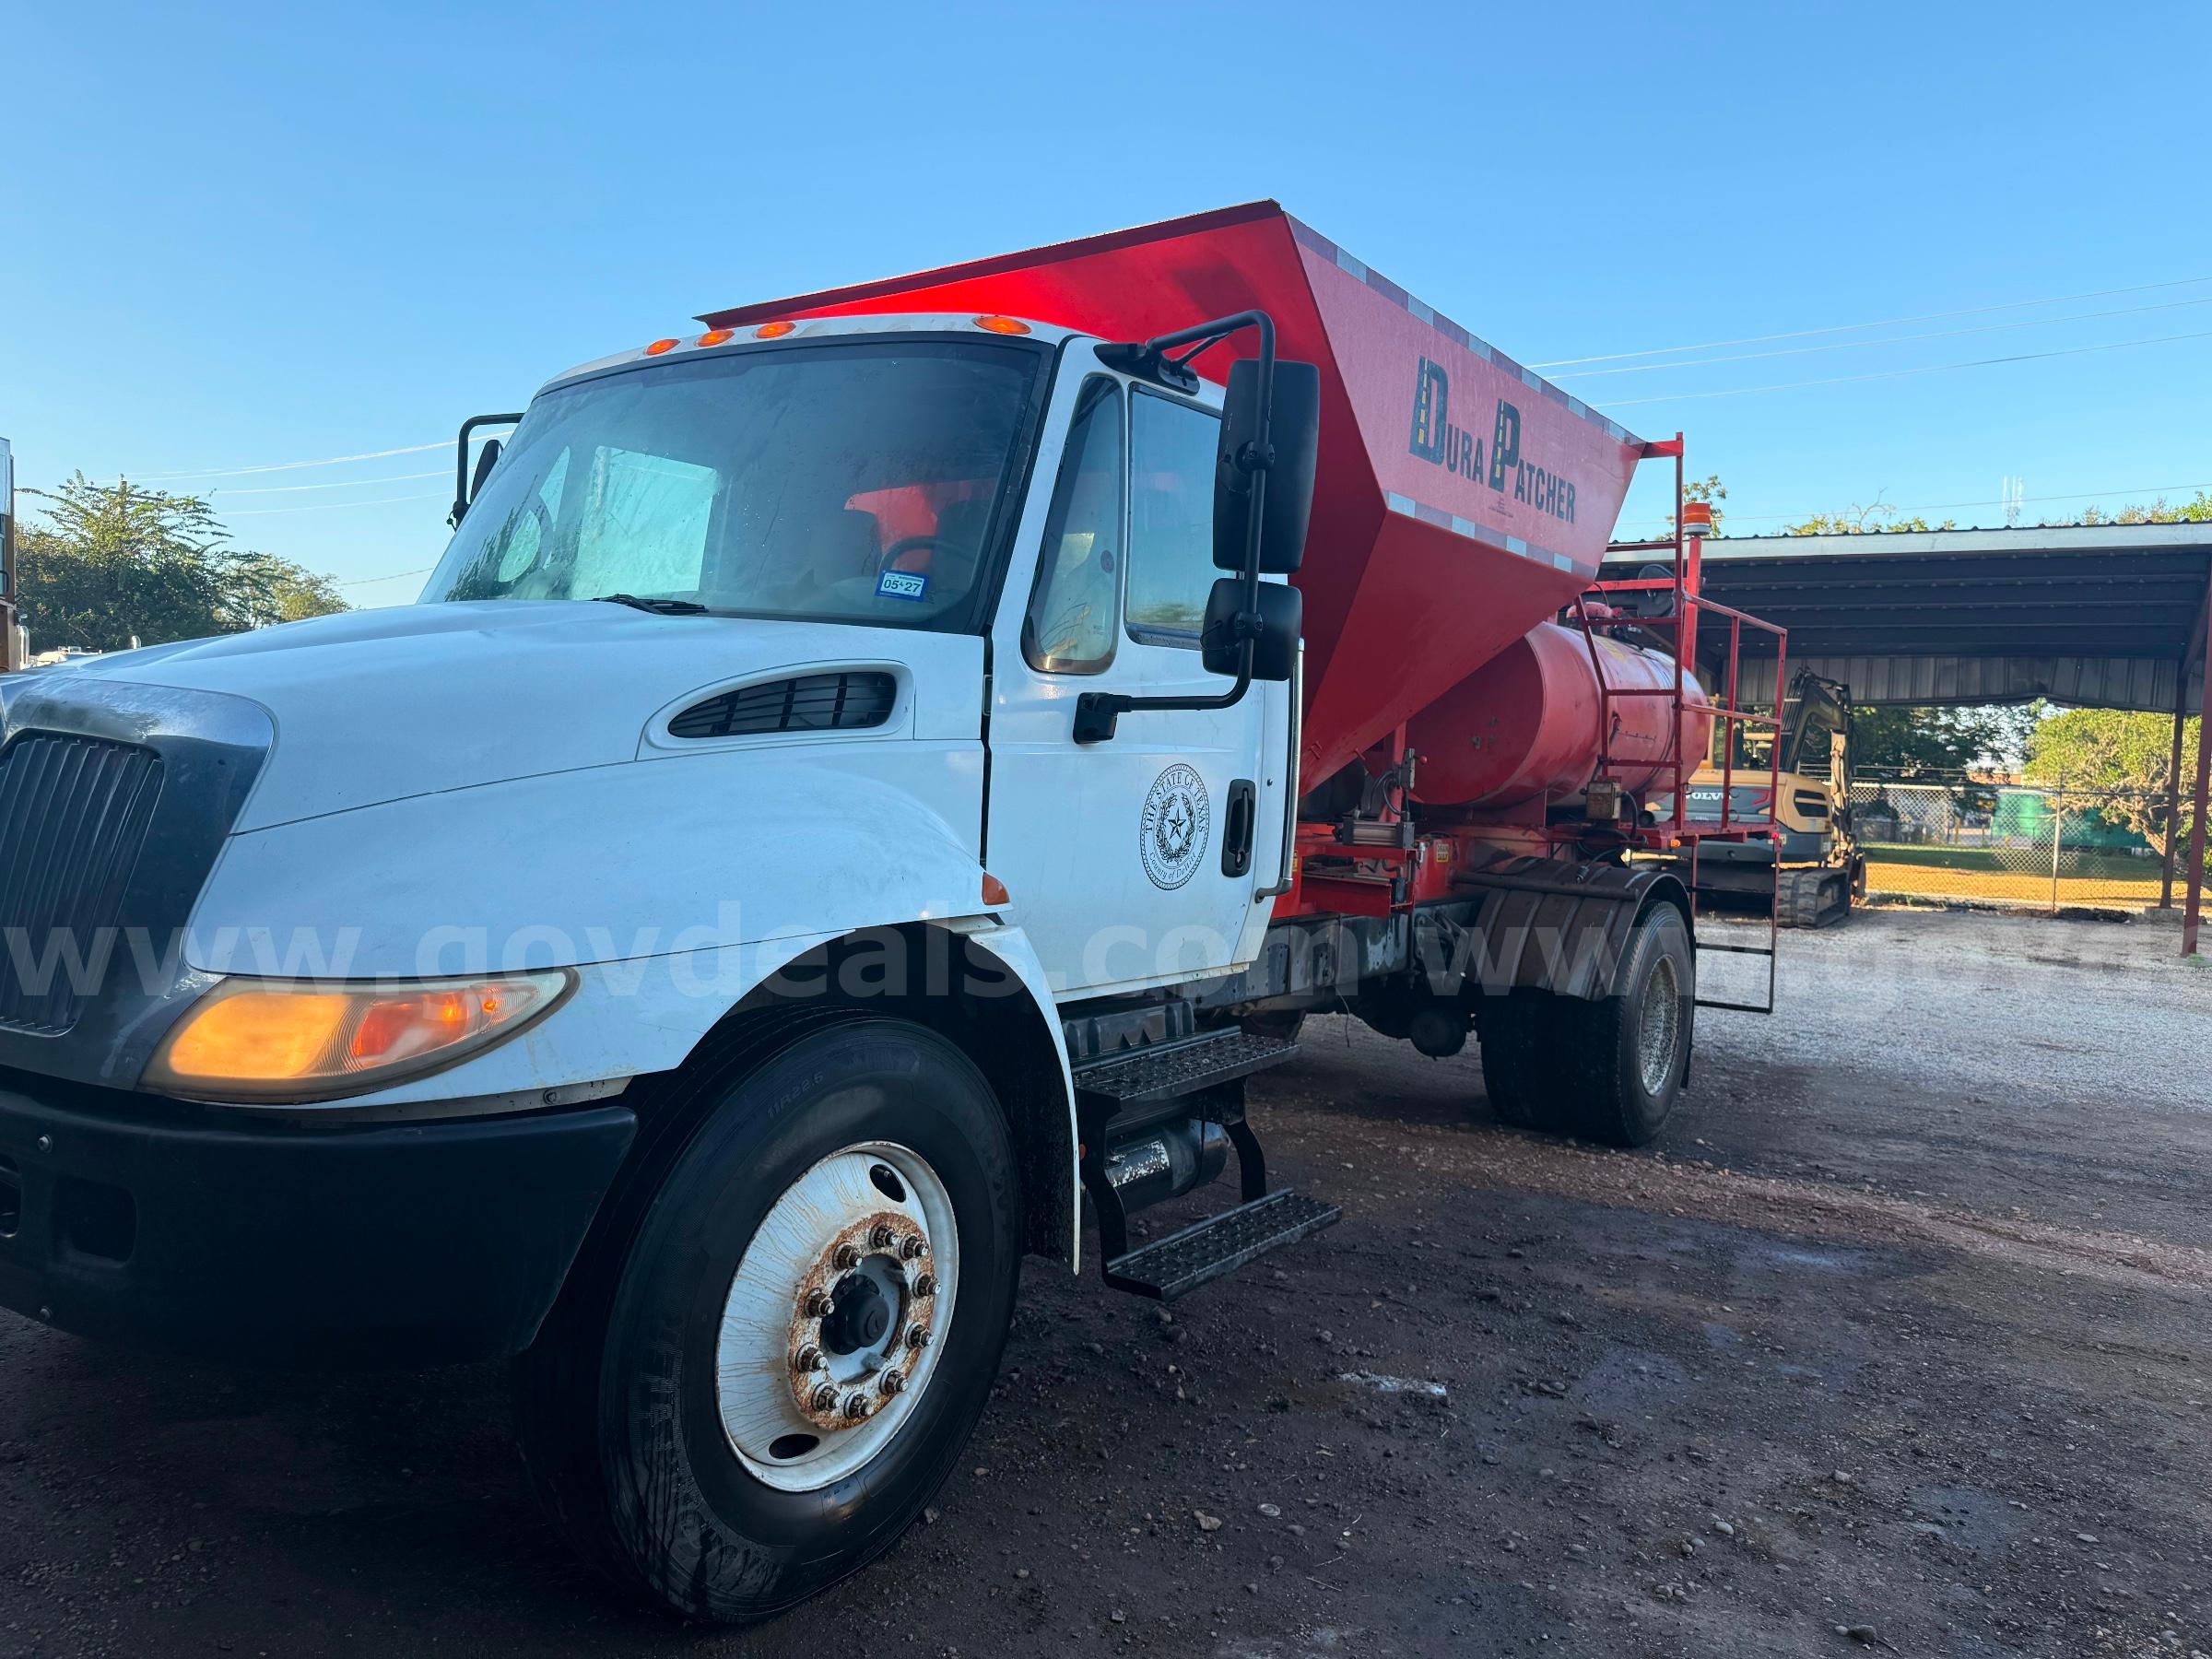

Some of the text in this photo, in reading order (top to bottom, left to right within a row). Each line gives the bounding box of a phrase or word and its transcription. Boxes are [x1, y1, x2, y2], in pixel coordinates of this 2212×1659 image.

[1408, 354, 1576, 524] DURA PATCHER
[1146, 801, 1158, 834] THE
[1156, 771, 1182, 800] STATE
[1194, 786, 1206, 833] TEXAS
[1148, 852, 1168, 880] County
